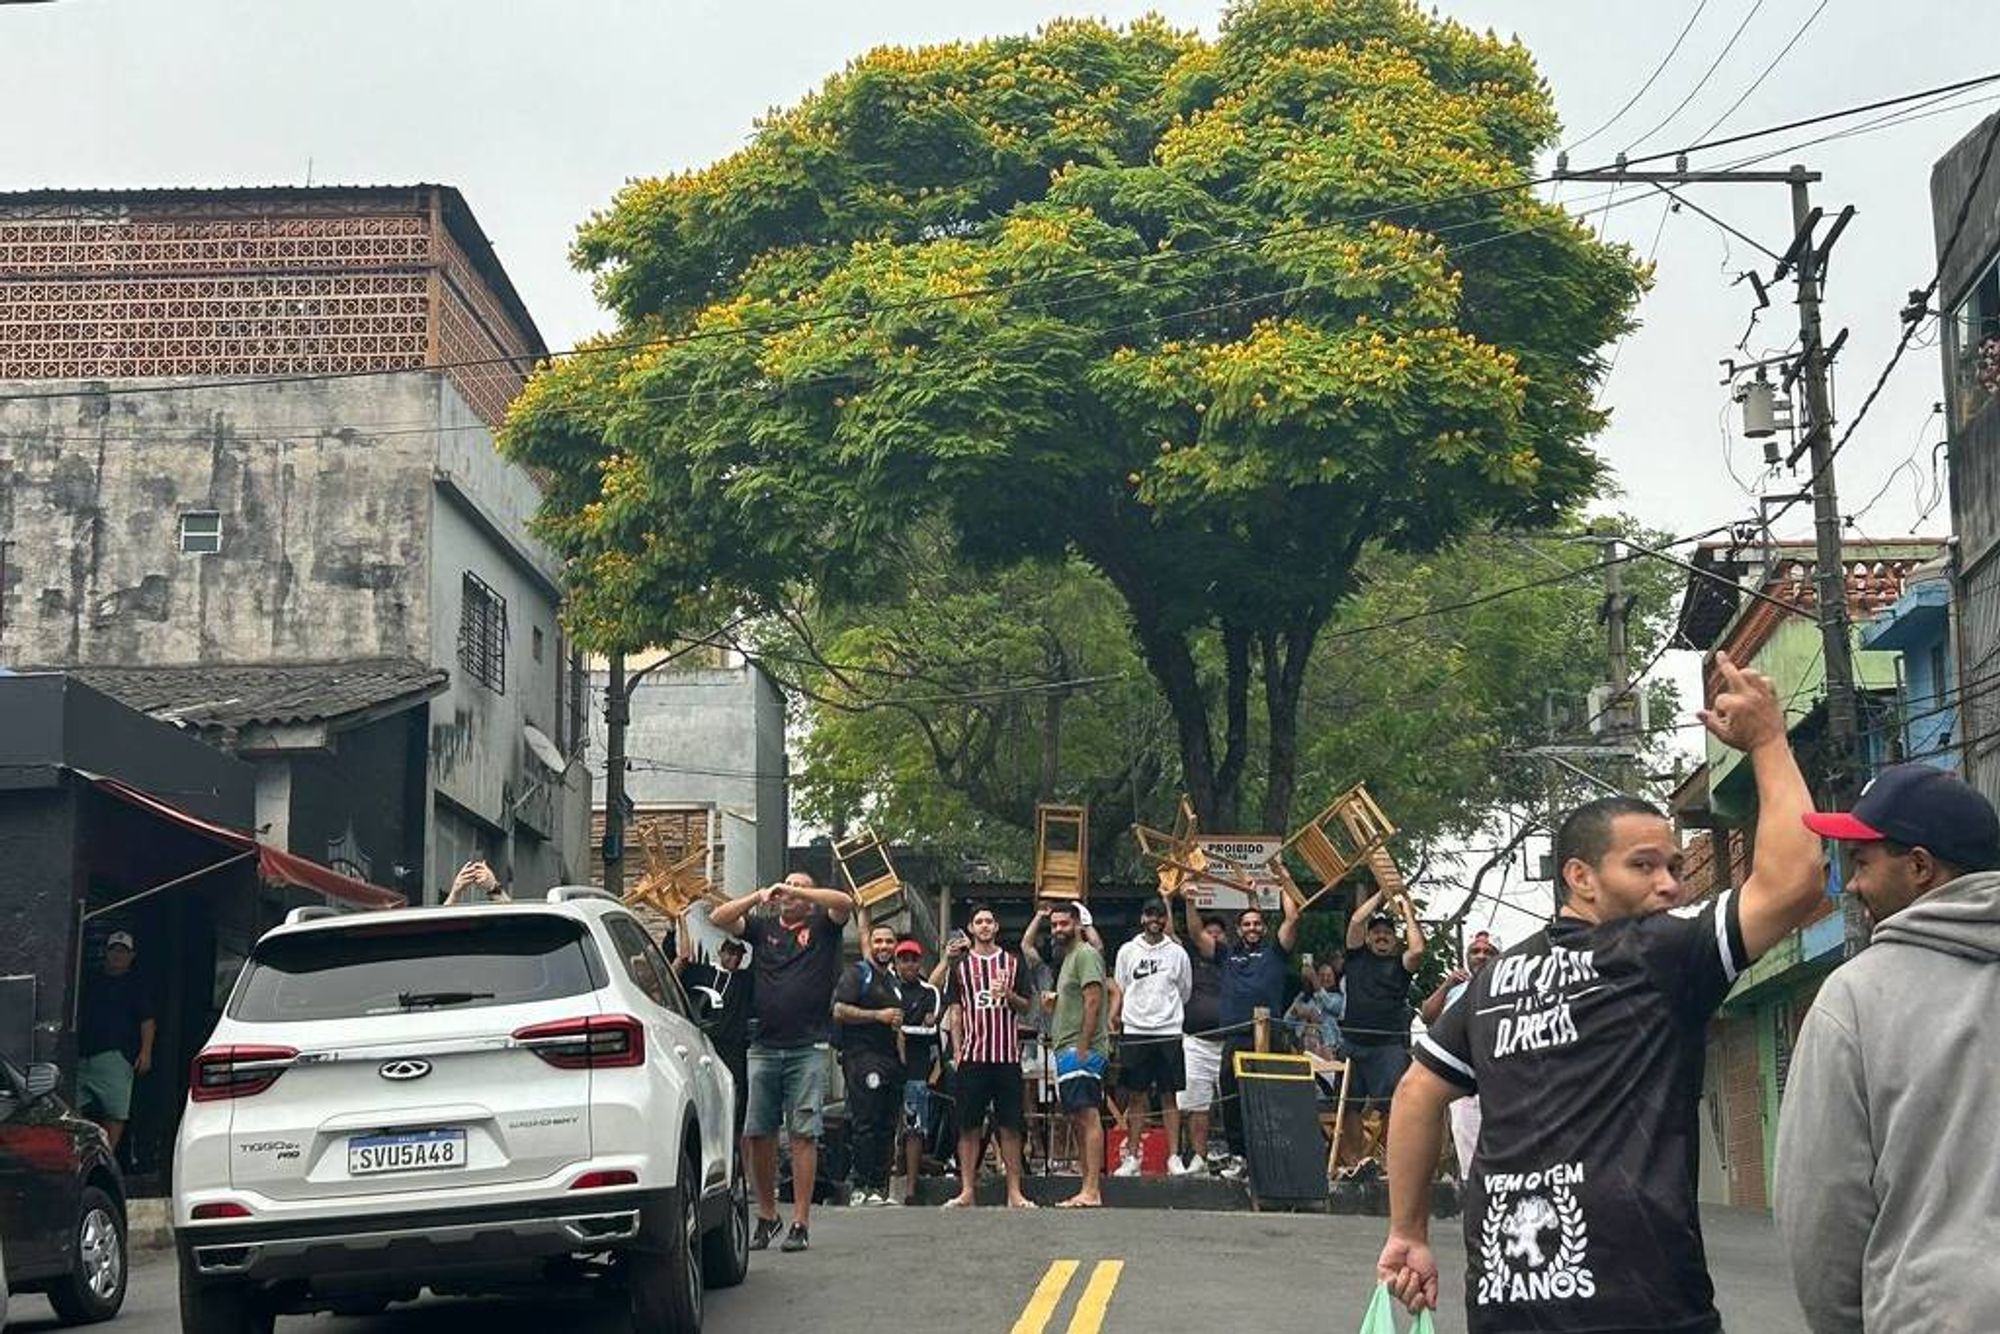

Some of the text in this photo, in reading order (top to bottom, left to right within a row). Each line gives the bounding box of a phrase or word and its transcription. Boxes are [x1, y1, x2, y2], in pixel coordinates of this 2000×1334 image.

[1208, 843, 1264, 854] PROIBIDO
[359, 1142, 454, 1169] SVU5A48
[1484, 1173, 1524, 1195] VEM
[1544, 1162, 1584, 1187] TEM
[1477, 1268, 1596, 1305] 24 ANOS
